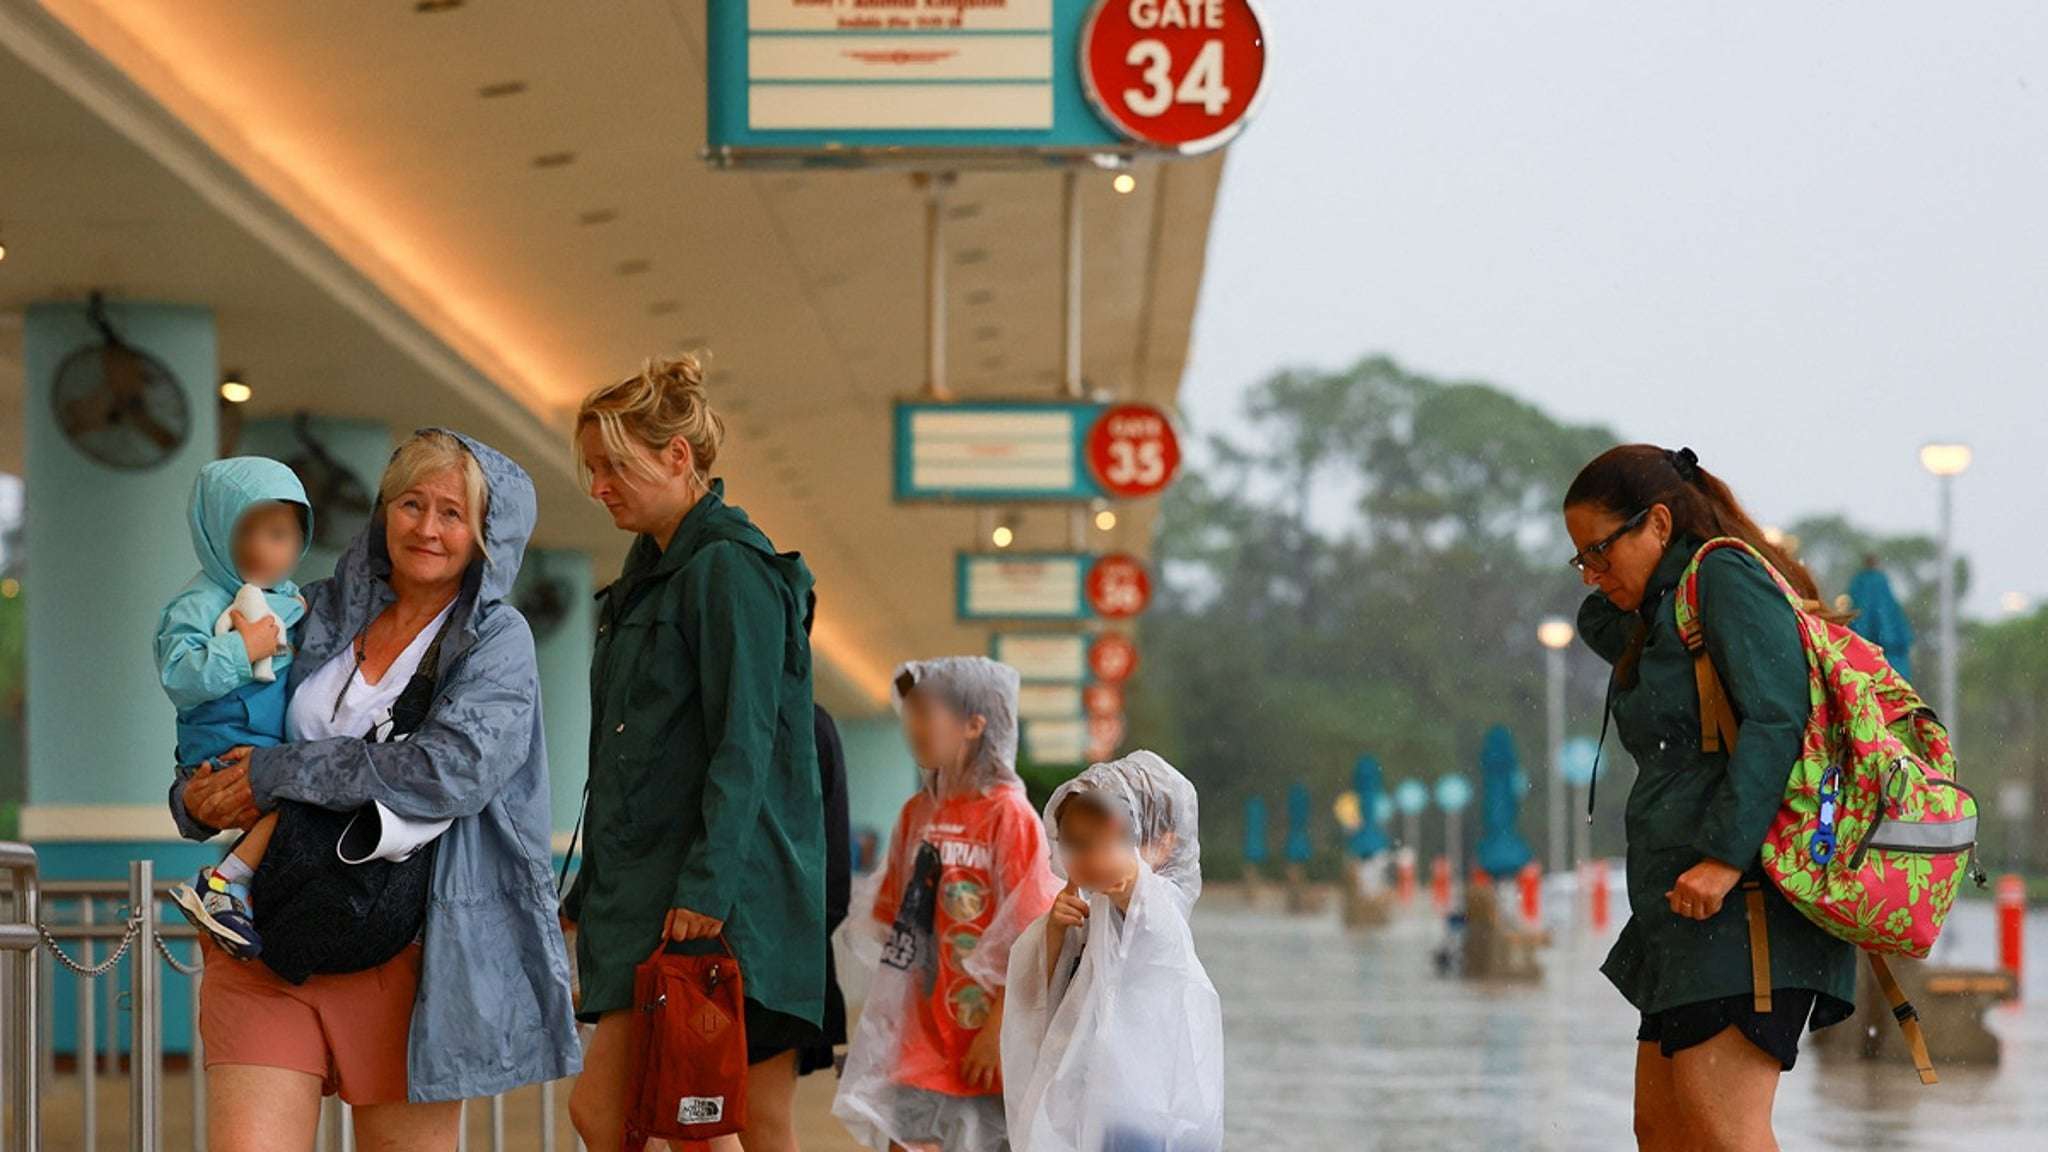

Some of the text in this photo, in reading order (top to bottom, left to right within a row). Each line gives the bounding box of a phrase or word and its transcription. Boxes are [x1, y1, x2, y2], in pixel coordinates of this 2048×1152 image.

[1128, 0, 1224, 30] GATE
[1122, 38, 1231, 118] 34
[1106, 440, 1165, 486] 35
